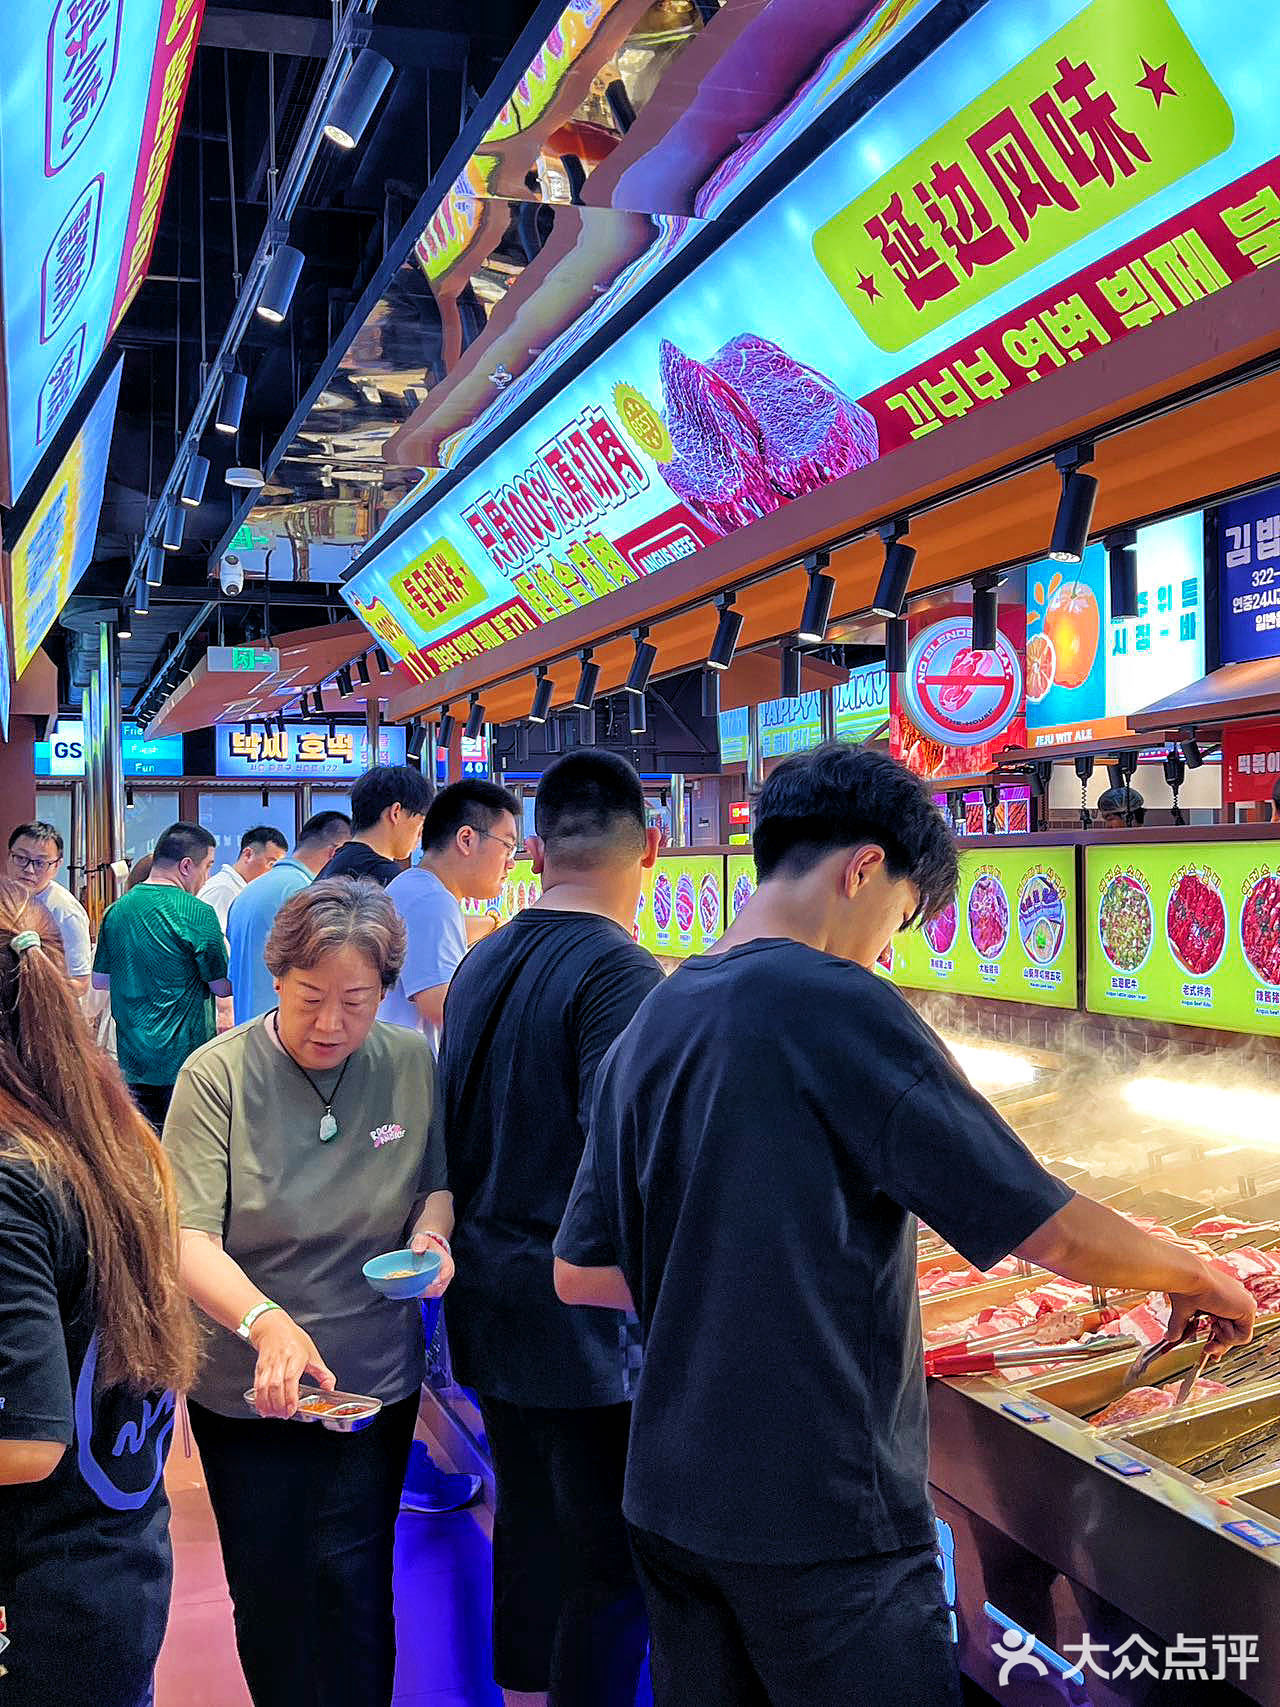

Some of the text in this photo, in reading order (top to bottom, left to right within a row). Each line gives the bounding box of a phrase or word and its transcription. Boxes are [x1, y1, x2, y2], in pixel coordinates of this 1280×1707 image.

[863, 56, 1153, 312] 延边风味
[1002, 293, 1111, 382] 연변
[1096, 228, 1232, 329] 뷔페
[631, 413, 655, 437] BEST
[462, 407, 650, 575] 只用100%原切肉
[491, 604, 538, 641] 불고기
[917, 661, 928, 684] NO
[924, 627, 973, 662] BLENDE
[54, 742, 82, 759] GS
[299, 732, 353, 763] 호떡
[1035, 729, 1093, 747] JEJU WIT ALE
[135, 763, 155, 773] Fun
